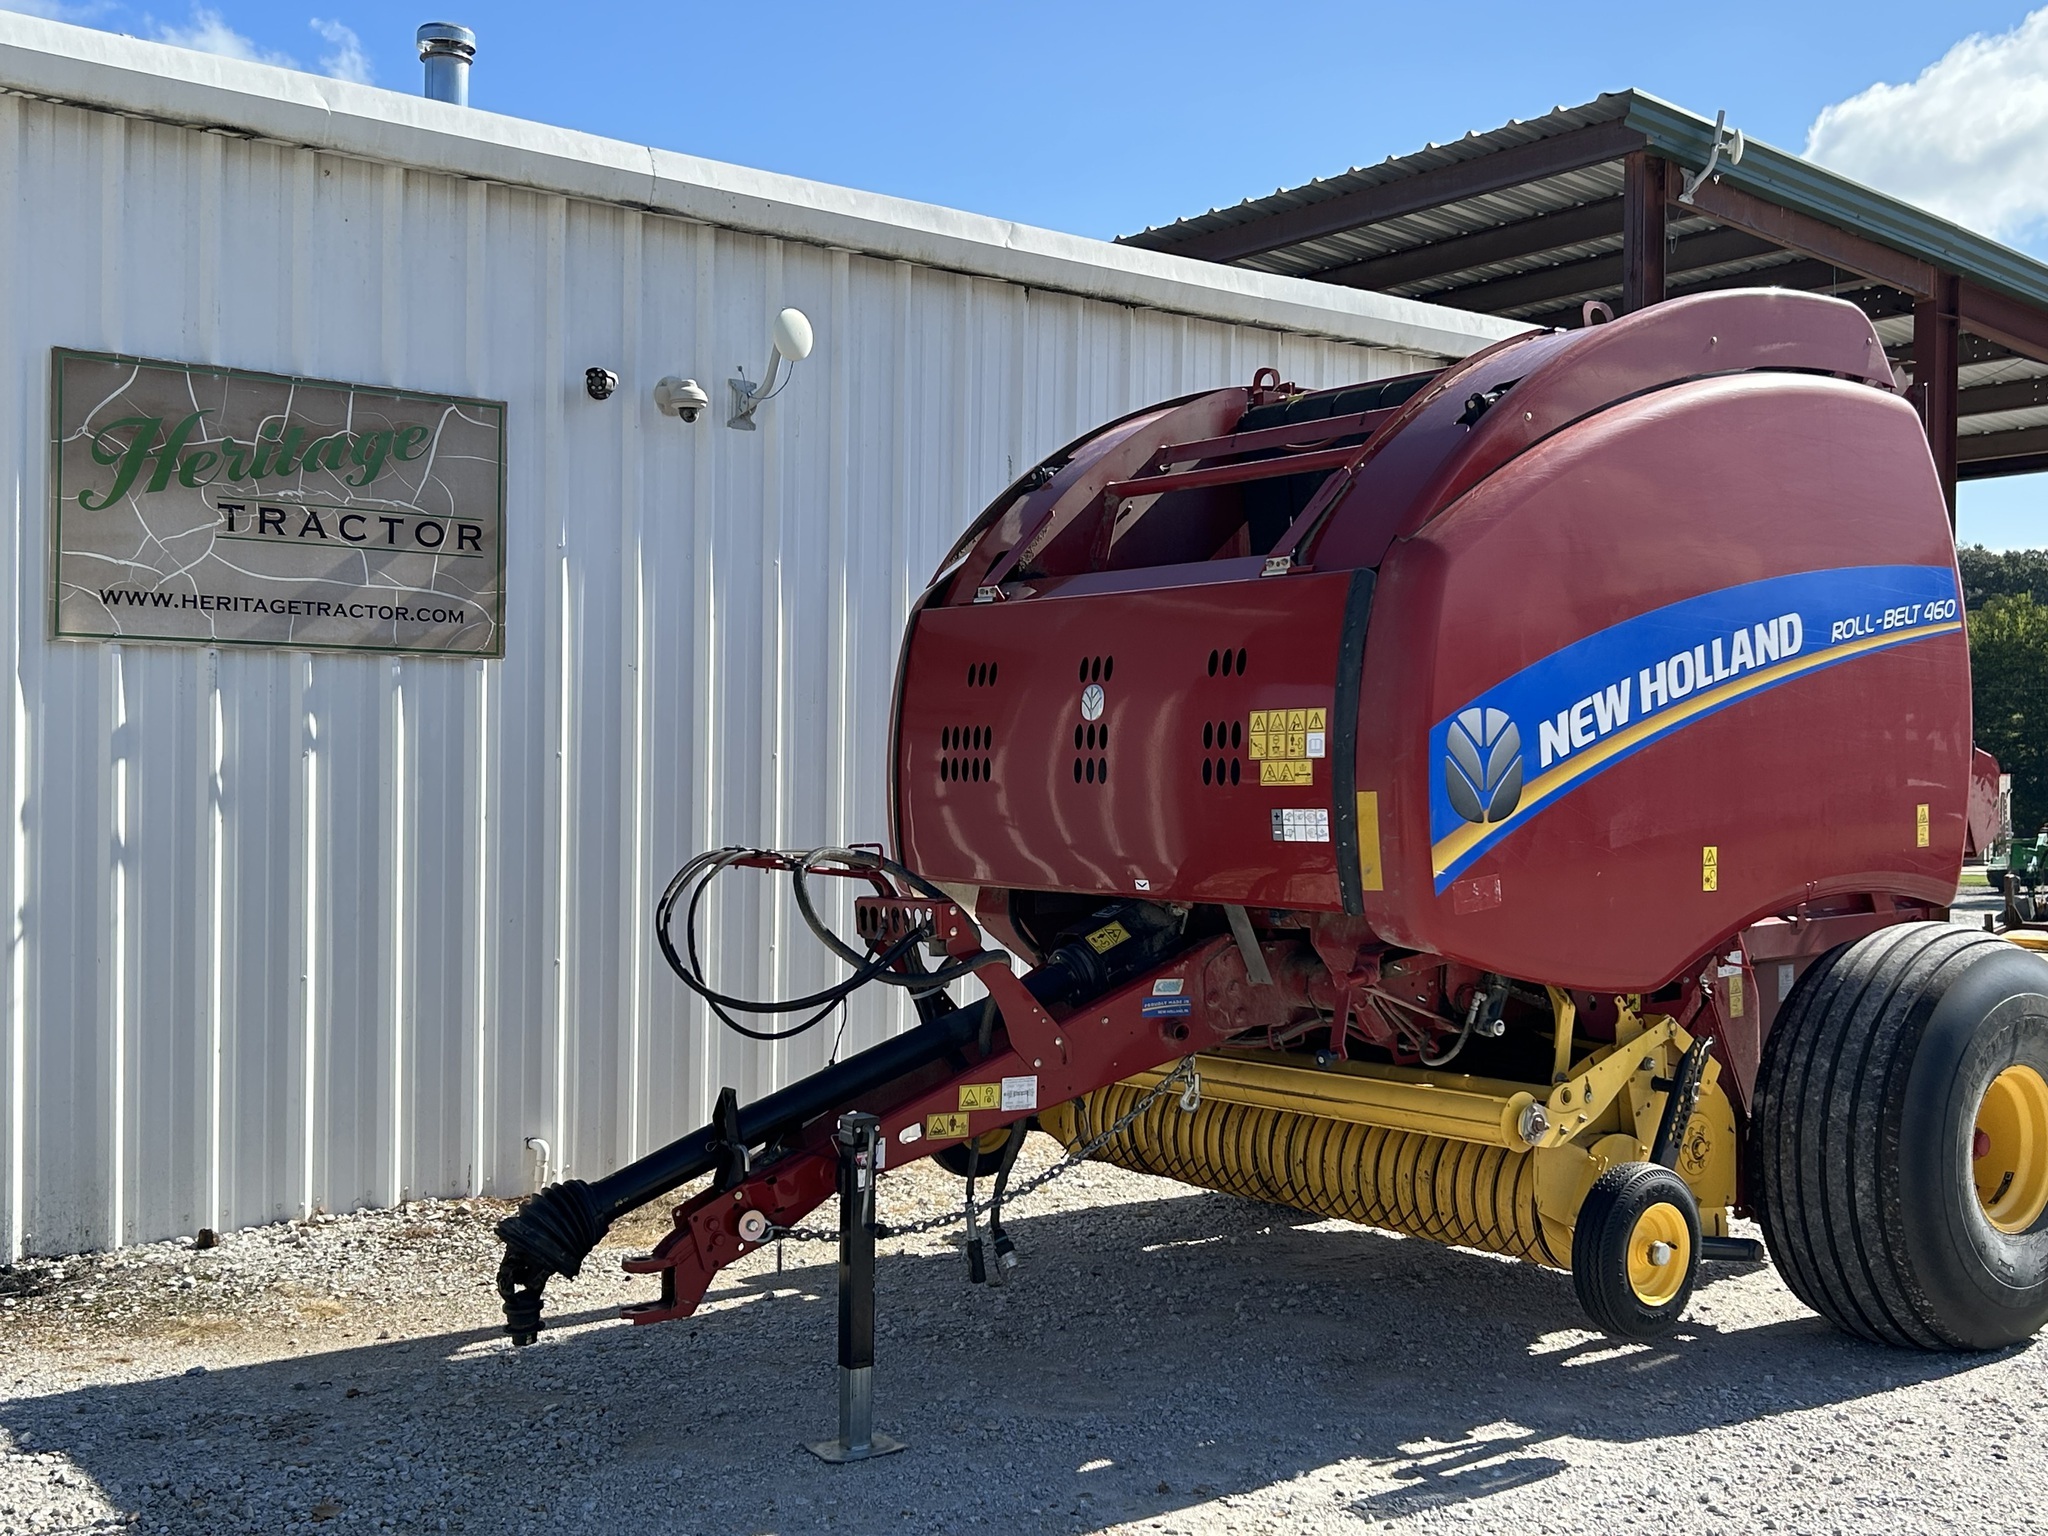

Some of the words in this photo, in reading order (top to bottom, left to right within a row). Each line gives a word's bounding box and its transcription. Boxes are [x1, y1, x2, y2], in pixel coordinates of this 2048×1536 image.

[79, 410, 432, 511] Heritage
[217, 502, 484, 552] TRACTOR
[99, 588, 465, 625] WWW.HERITAGETRACTOR.COM
[1831, 604, 1922, 643] ROLL-BELT
[1924, 599, 1956, 622] 460
[1539, 678, 1631, 769] NEW
[1640, 612, 1803, 714] HOLLAND
